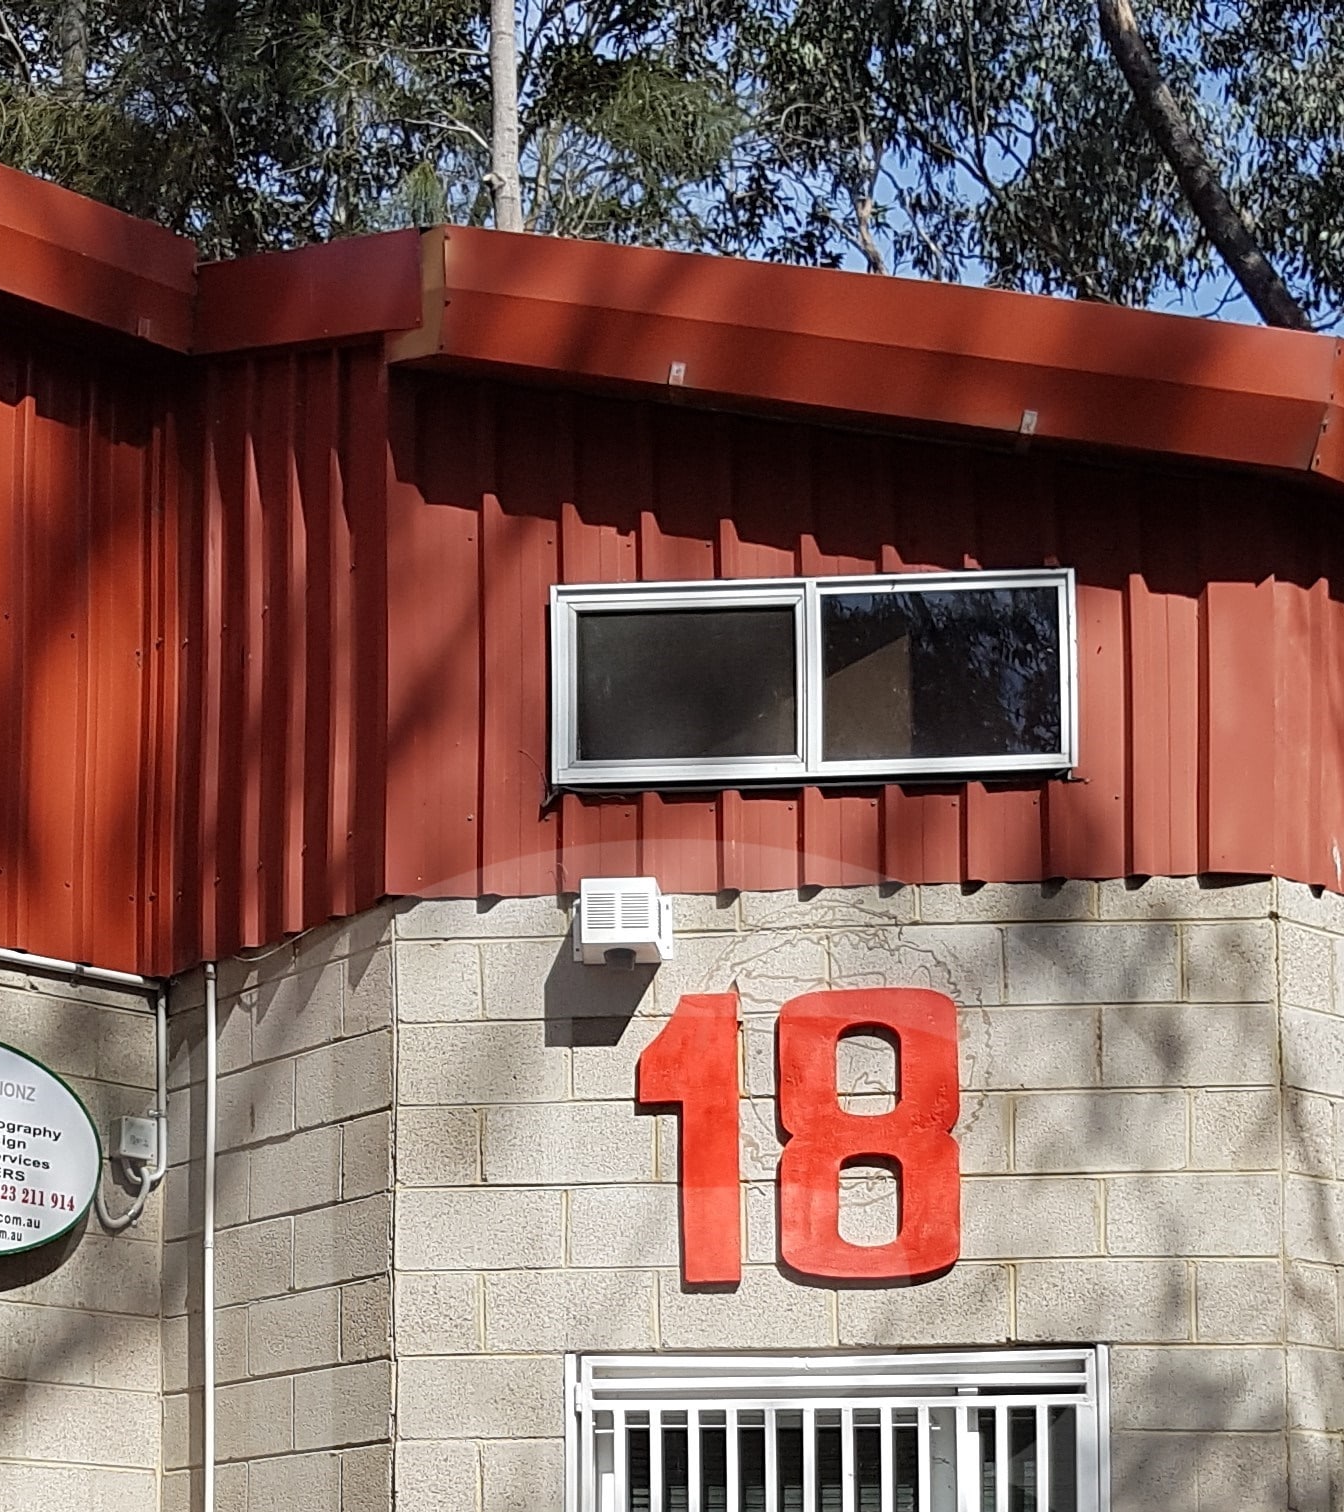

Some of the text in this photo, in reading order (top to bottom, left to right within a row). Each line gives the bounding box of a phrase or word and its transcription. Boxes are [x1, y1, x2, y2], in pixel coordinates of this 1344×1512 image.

[22, 1188, 46, 1208] 211
[51, 1192, 76, 1212] 914
[639, 987, 960, 1285] 18
